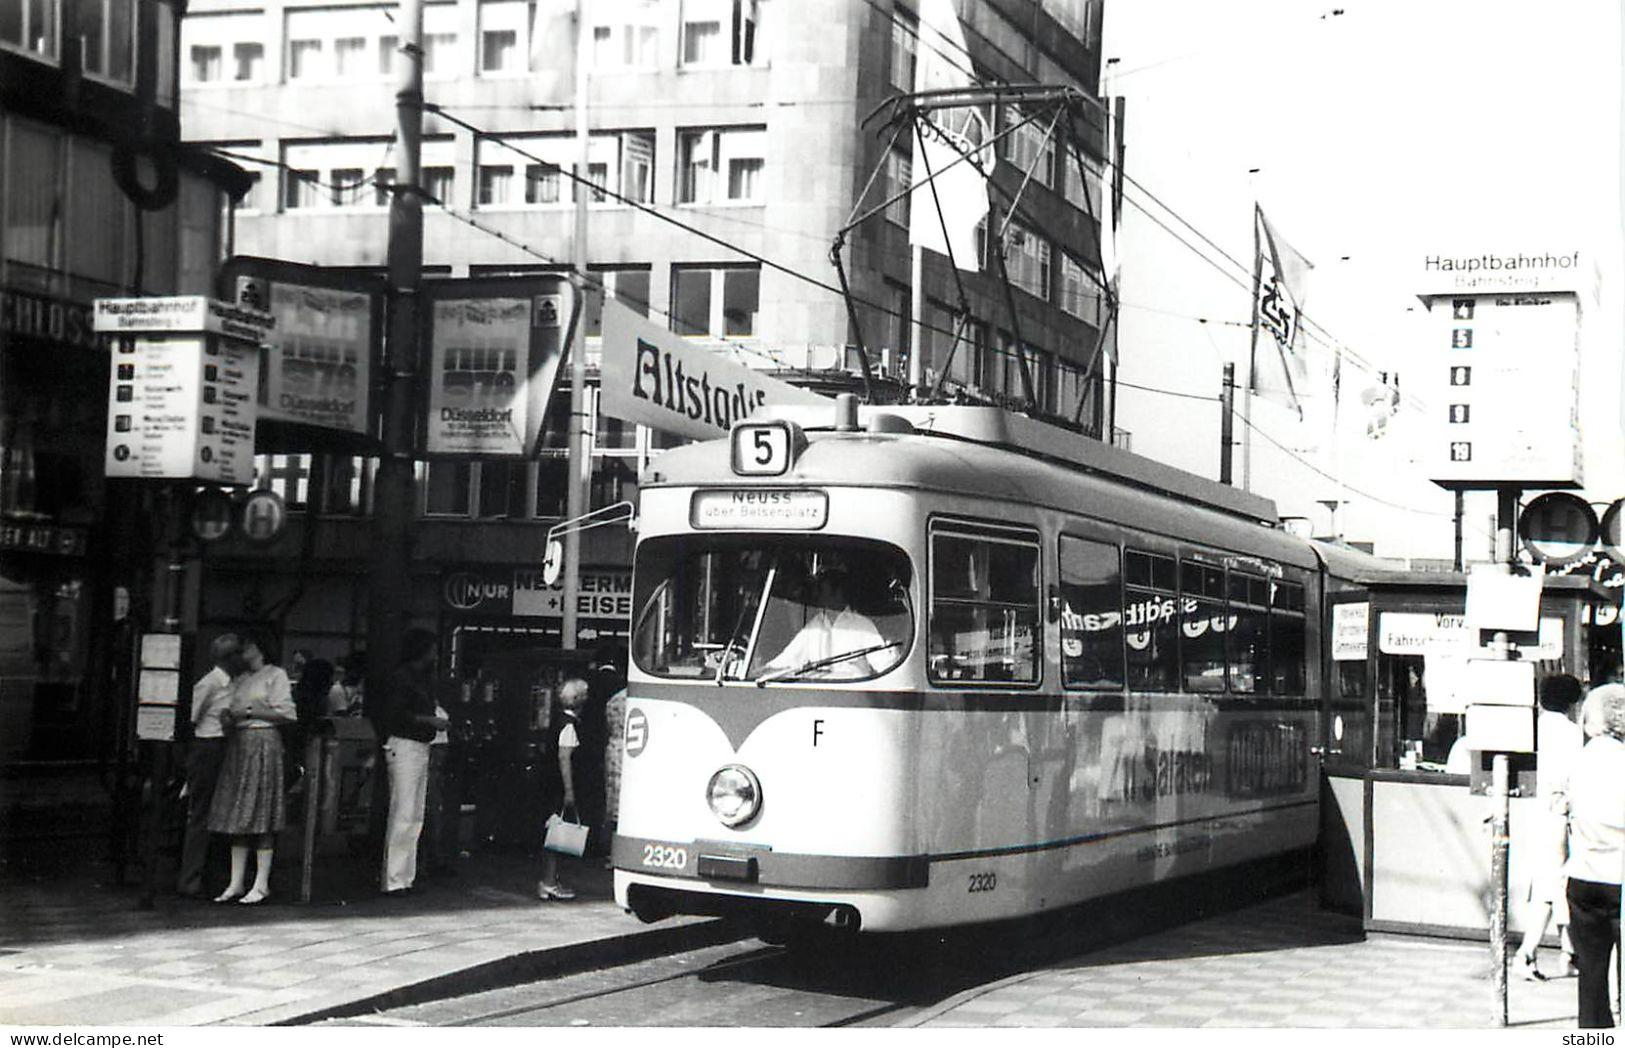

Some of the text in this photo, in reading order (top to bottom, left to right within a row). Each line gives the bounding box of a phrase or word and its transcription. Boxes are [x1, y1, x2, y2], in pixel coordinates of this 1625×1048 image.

[1425, 251, 1579, 273] Hauptbahnhof
[99, 301, 198, 316] Hauptbahnhof
[440, 407, 513, 423] Düsseldorf
[753, 430, 774, 465] 5
[1452, 441, 1470, 461] 19
[732, 490, 792, 504] Neuss
[467, 584, 509, 599] NUR
[813, 719, 825, 747] F
[643, 845, 688, 869] 2320
[968, 872, 997, 893] 2320
